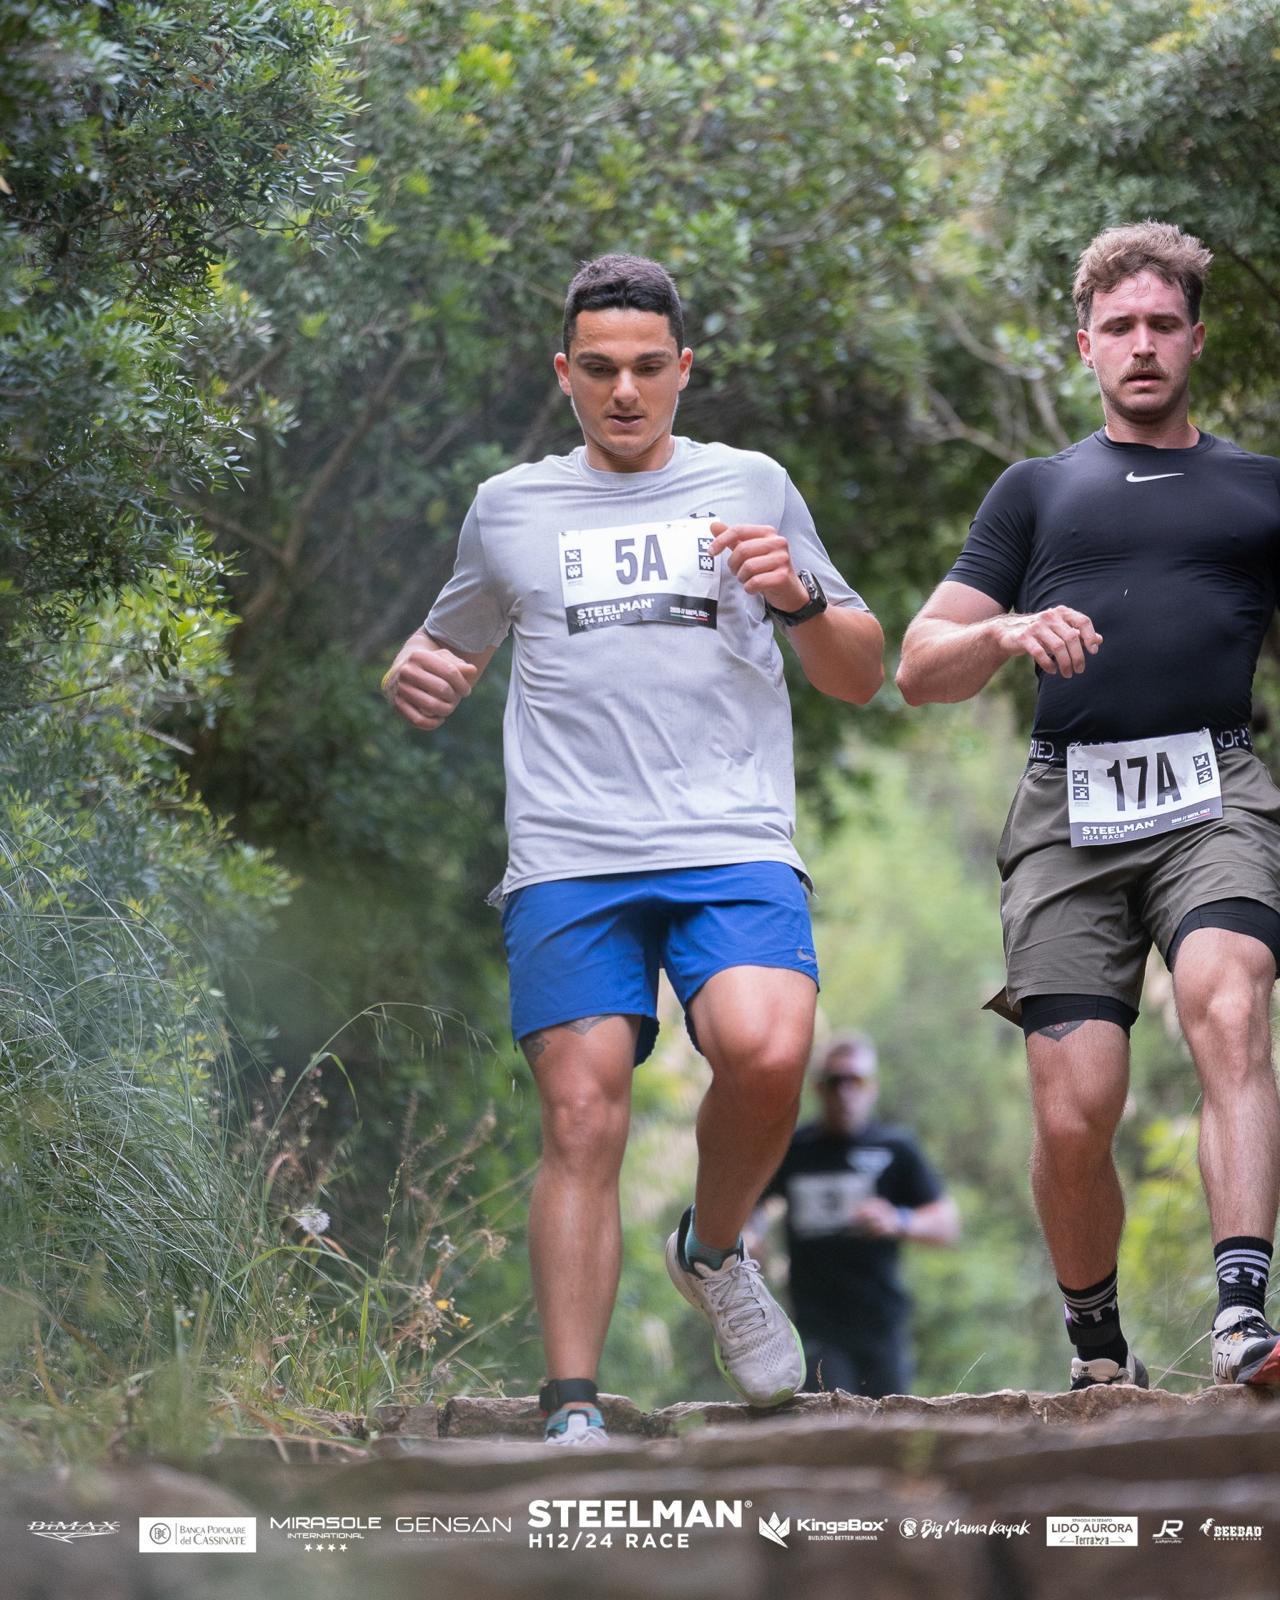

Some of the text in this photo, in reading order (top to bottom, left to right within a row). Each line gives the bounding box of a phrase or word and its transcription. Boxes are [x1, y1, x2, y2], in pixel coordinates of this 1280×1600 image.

[615, 534, 668, 585] 5A
[576, 598, 653, 620] STEELMAN
[597, 614, 621, 623] RACE
[1106, 752, 1182, 811] 17A
[1082, 820, 1155, 835] STEELMAN
[1082, 833, 1099, 841] H24
